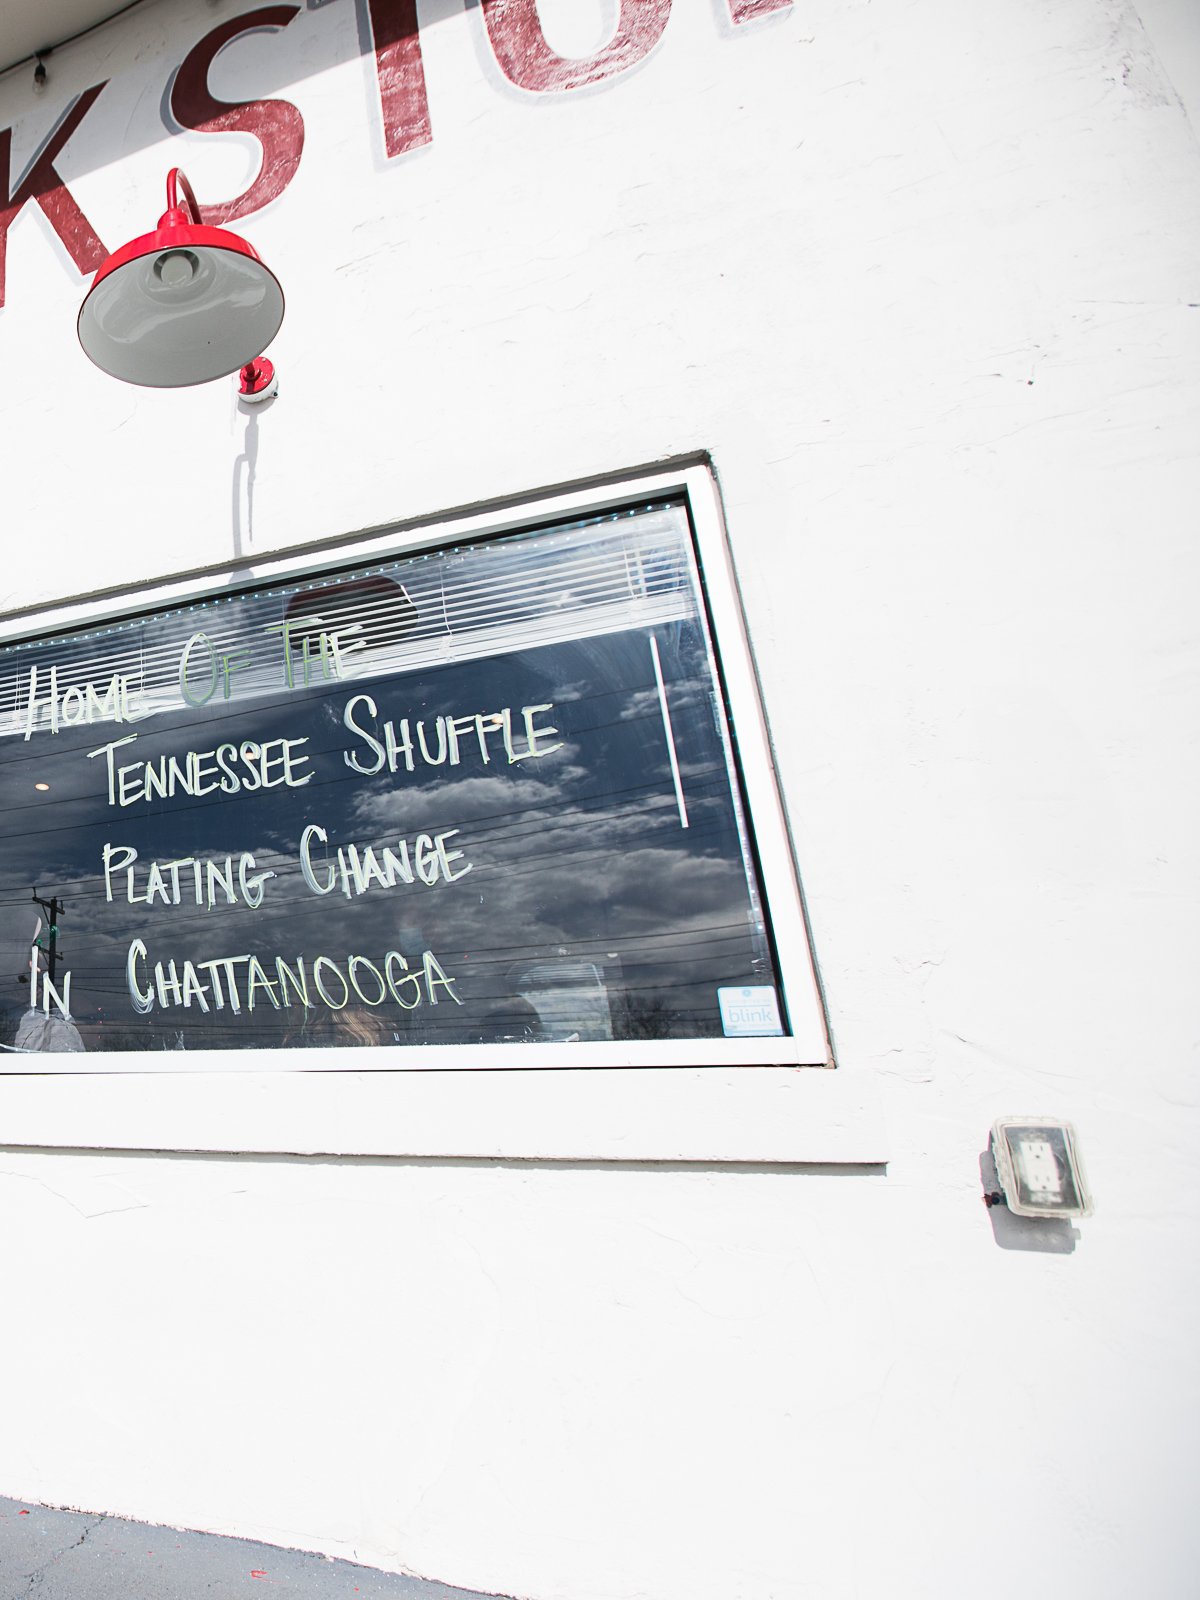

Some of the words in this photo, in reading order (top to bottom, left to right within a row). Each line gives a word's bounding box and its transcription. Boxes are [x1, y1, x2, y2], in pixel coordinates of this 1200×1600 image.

[87, 733, 316, 806] TENNESSEE
[344, 695, 565, 775] SHUFFLE
[102, 843, 278, 910] PLATING
[300, 825, 474, 899] CHANGE
[30, 945, 75, 1021] IN
[125, 938, 465, 1016] CHATTANOOGA
[729, 1008, 773, 1023] blink
